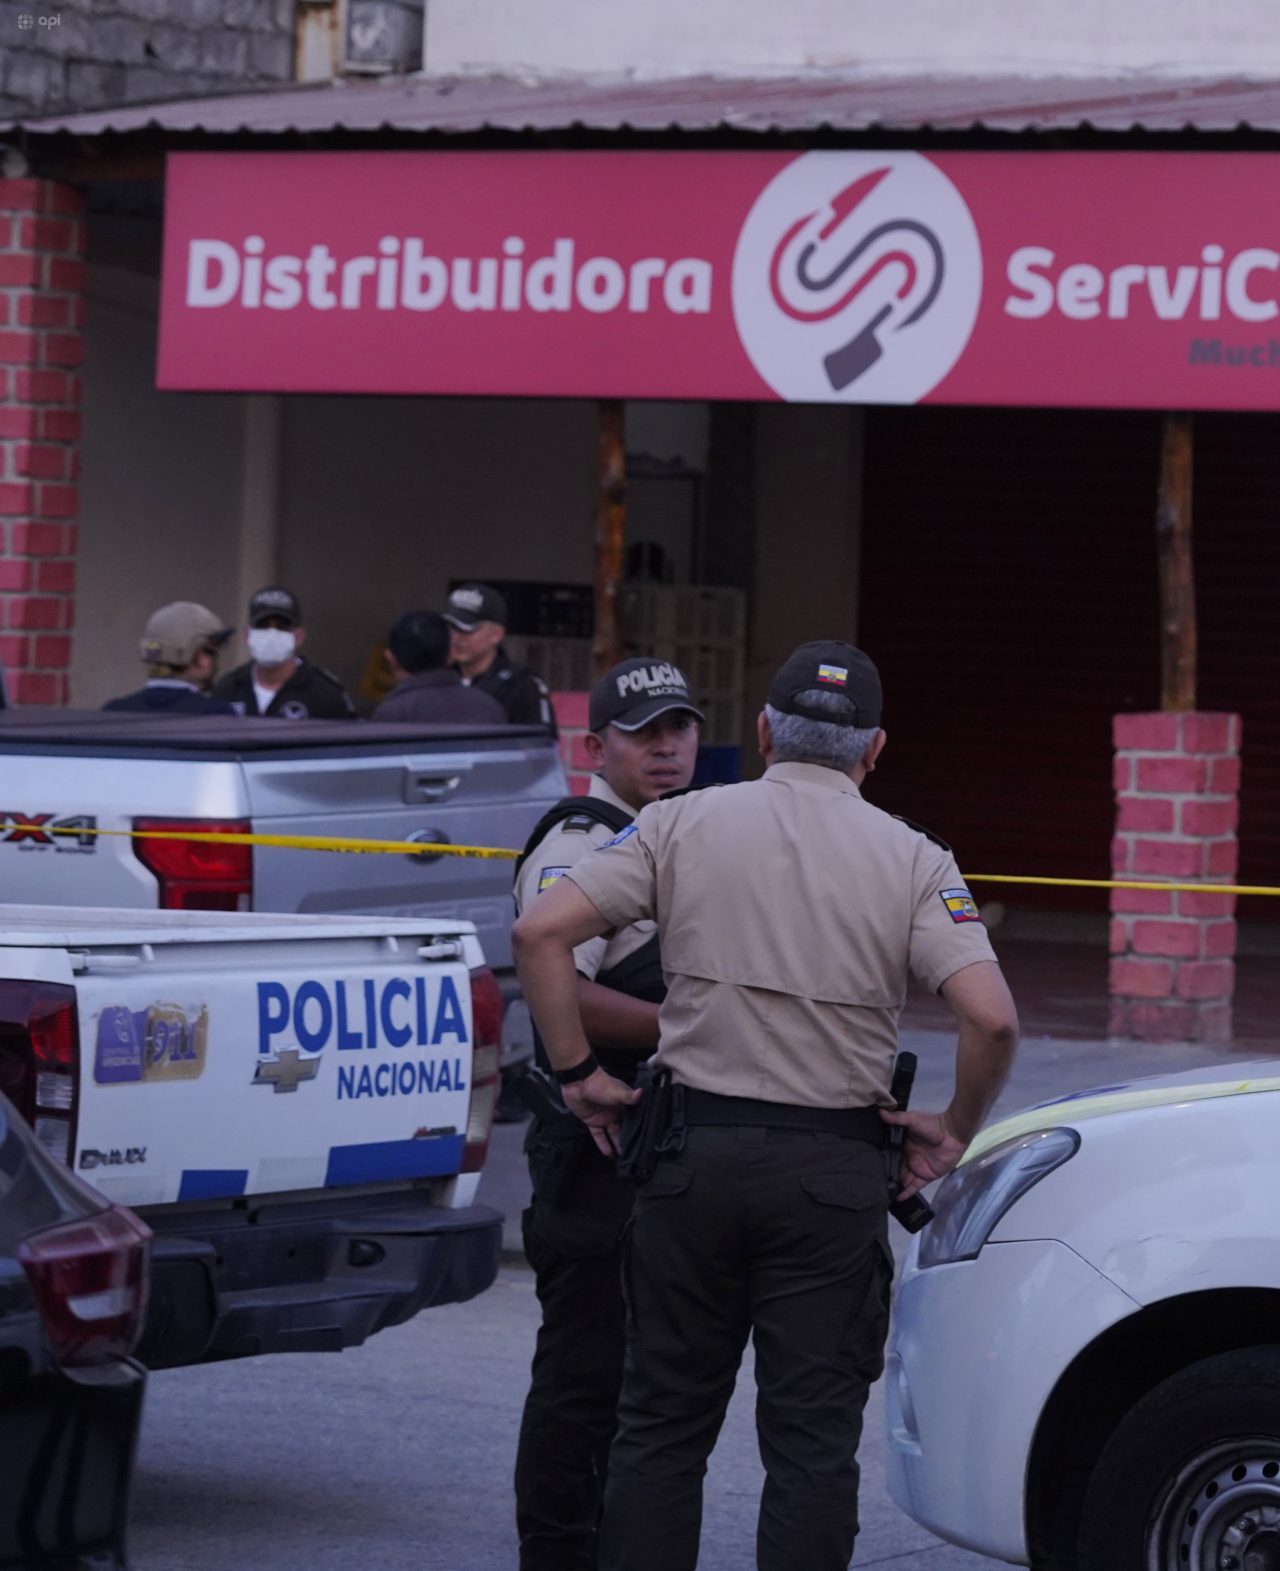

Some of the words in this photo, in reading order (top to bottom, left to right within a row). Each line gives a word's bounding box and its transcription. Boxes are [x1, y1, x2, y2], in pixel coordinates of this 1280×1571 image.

[186, 235, 712, 313] Distribuidora
[257, 975, 468, 1053] POLICIA
[337, 1058, 465, 1100] NACIONAL
